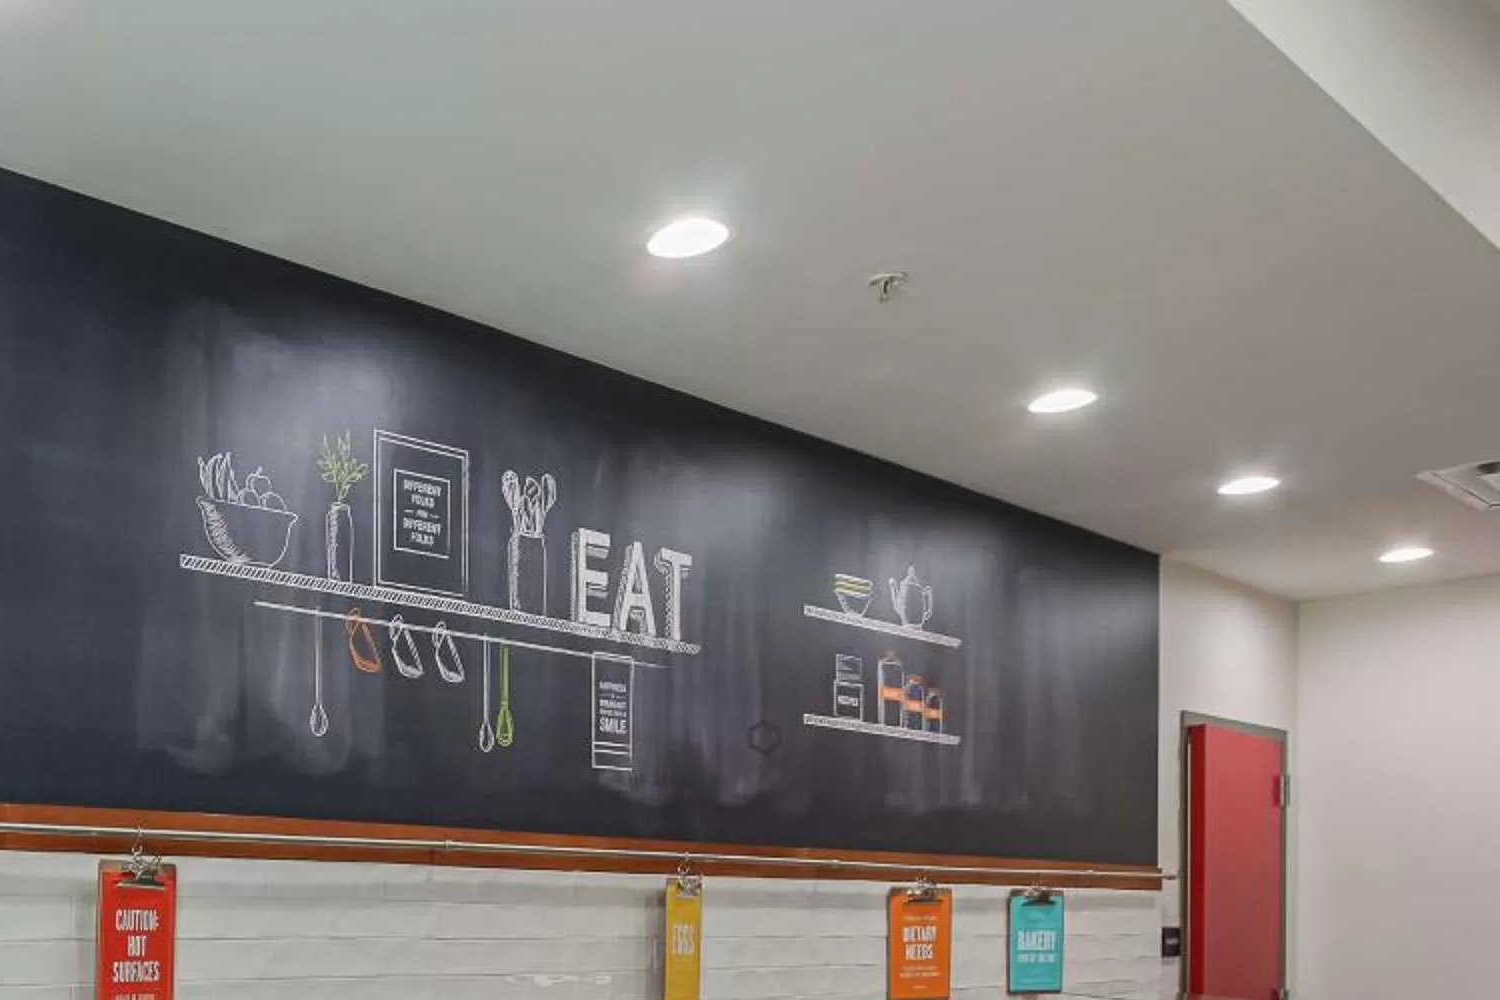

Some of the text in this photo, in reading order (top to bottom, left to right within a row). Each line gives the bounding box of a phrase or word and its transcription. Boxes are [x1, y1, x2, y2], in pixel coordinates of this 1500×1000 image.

[572, 527, 694, 642] EAT
[127, 935, 147, 957] HOT
[1017, 930, 1056, 951] BAKERY
